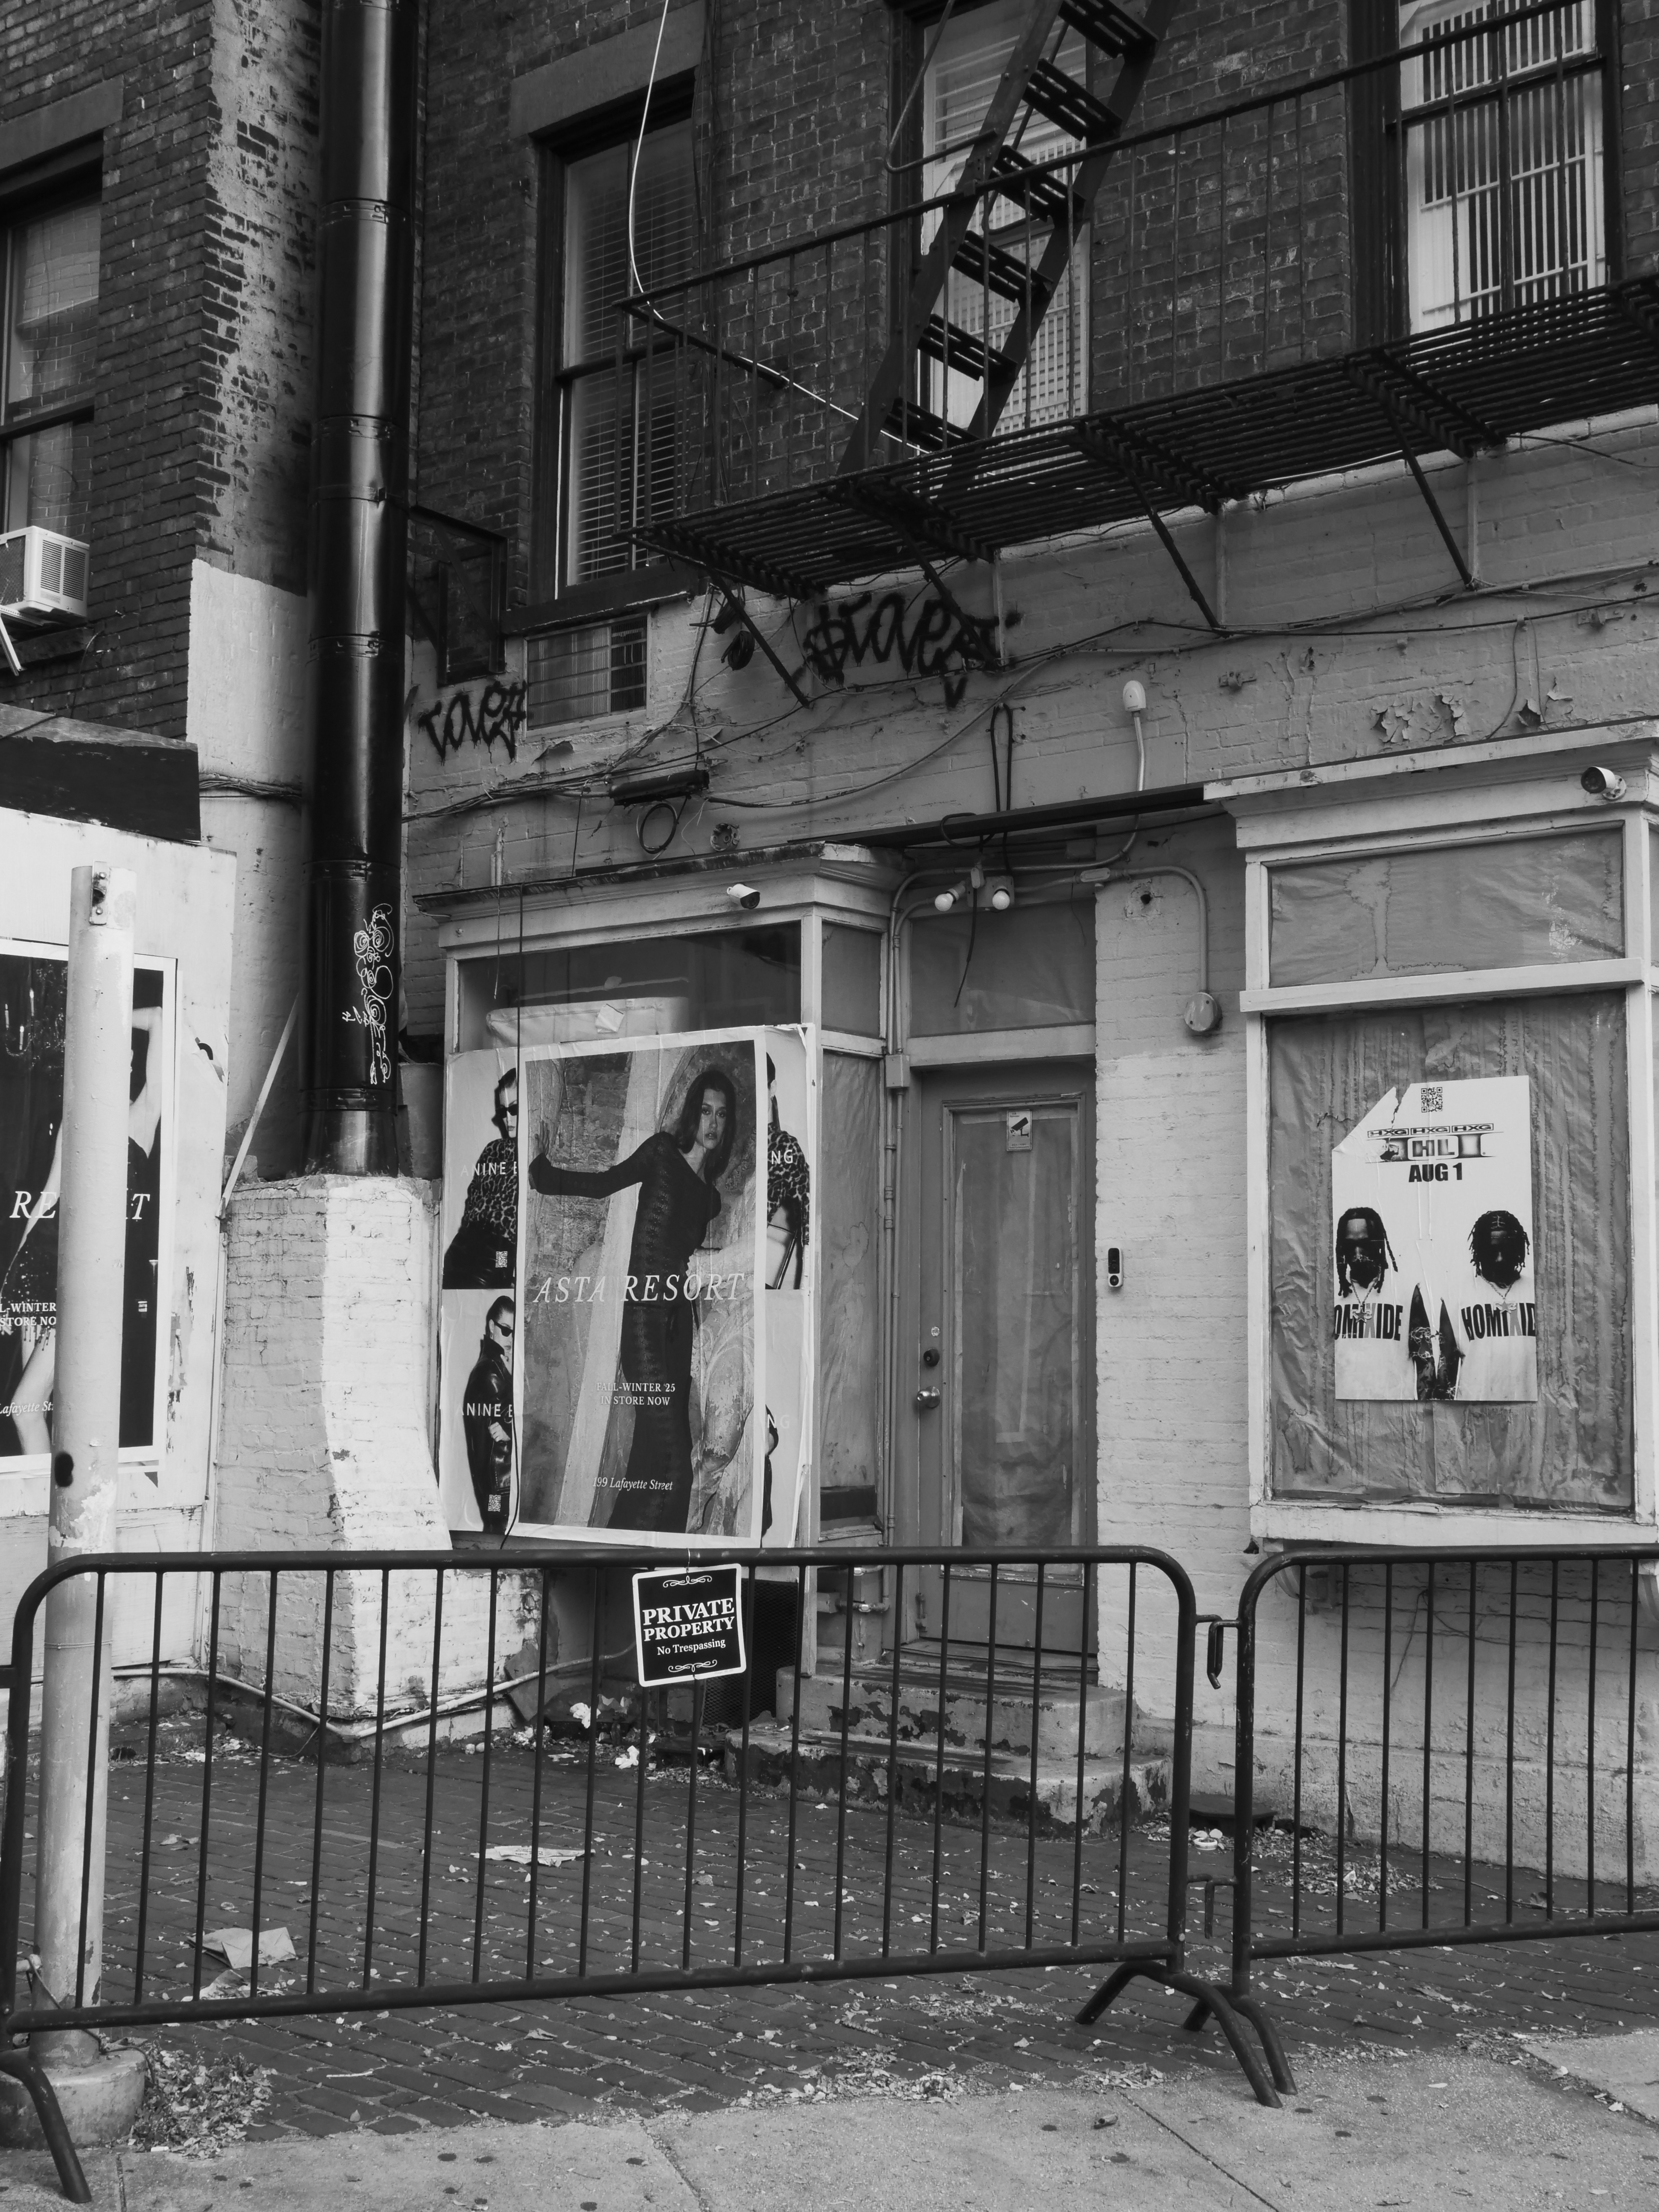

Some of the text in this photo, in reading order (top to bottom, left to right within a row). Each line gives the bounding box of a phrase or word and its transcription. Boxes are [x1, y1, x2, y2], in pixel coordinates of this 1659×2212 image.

[1412, 1126, 1449, 1135] HXG
[1453, 1124, 1492, 1132] HXG
[1409, 1162, 1462, 1182] AUG 1
[533, 1272, 745, 1303] ASTA RESORT
[0, 1316, 37, 1327] STORE
[597, 1382, 662, 1392] FALL-WINTER
[601, 1396, 671, 1406] IN STORE NOW
[593, 1477, 673, 1491] 199 Lafayette Street
[642, 1598, 735, 1626] PRIVATE
[643, 1616, 735, 1642] PROPERTY
[657, 1639, 726, 1655] No Trespassing
